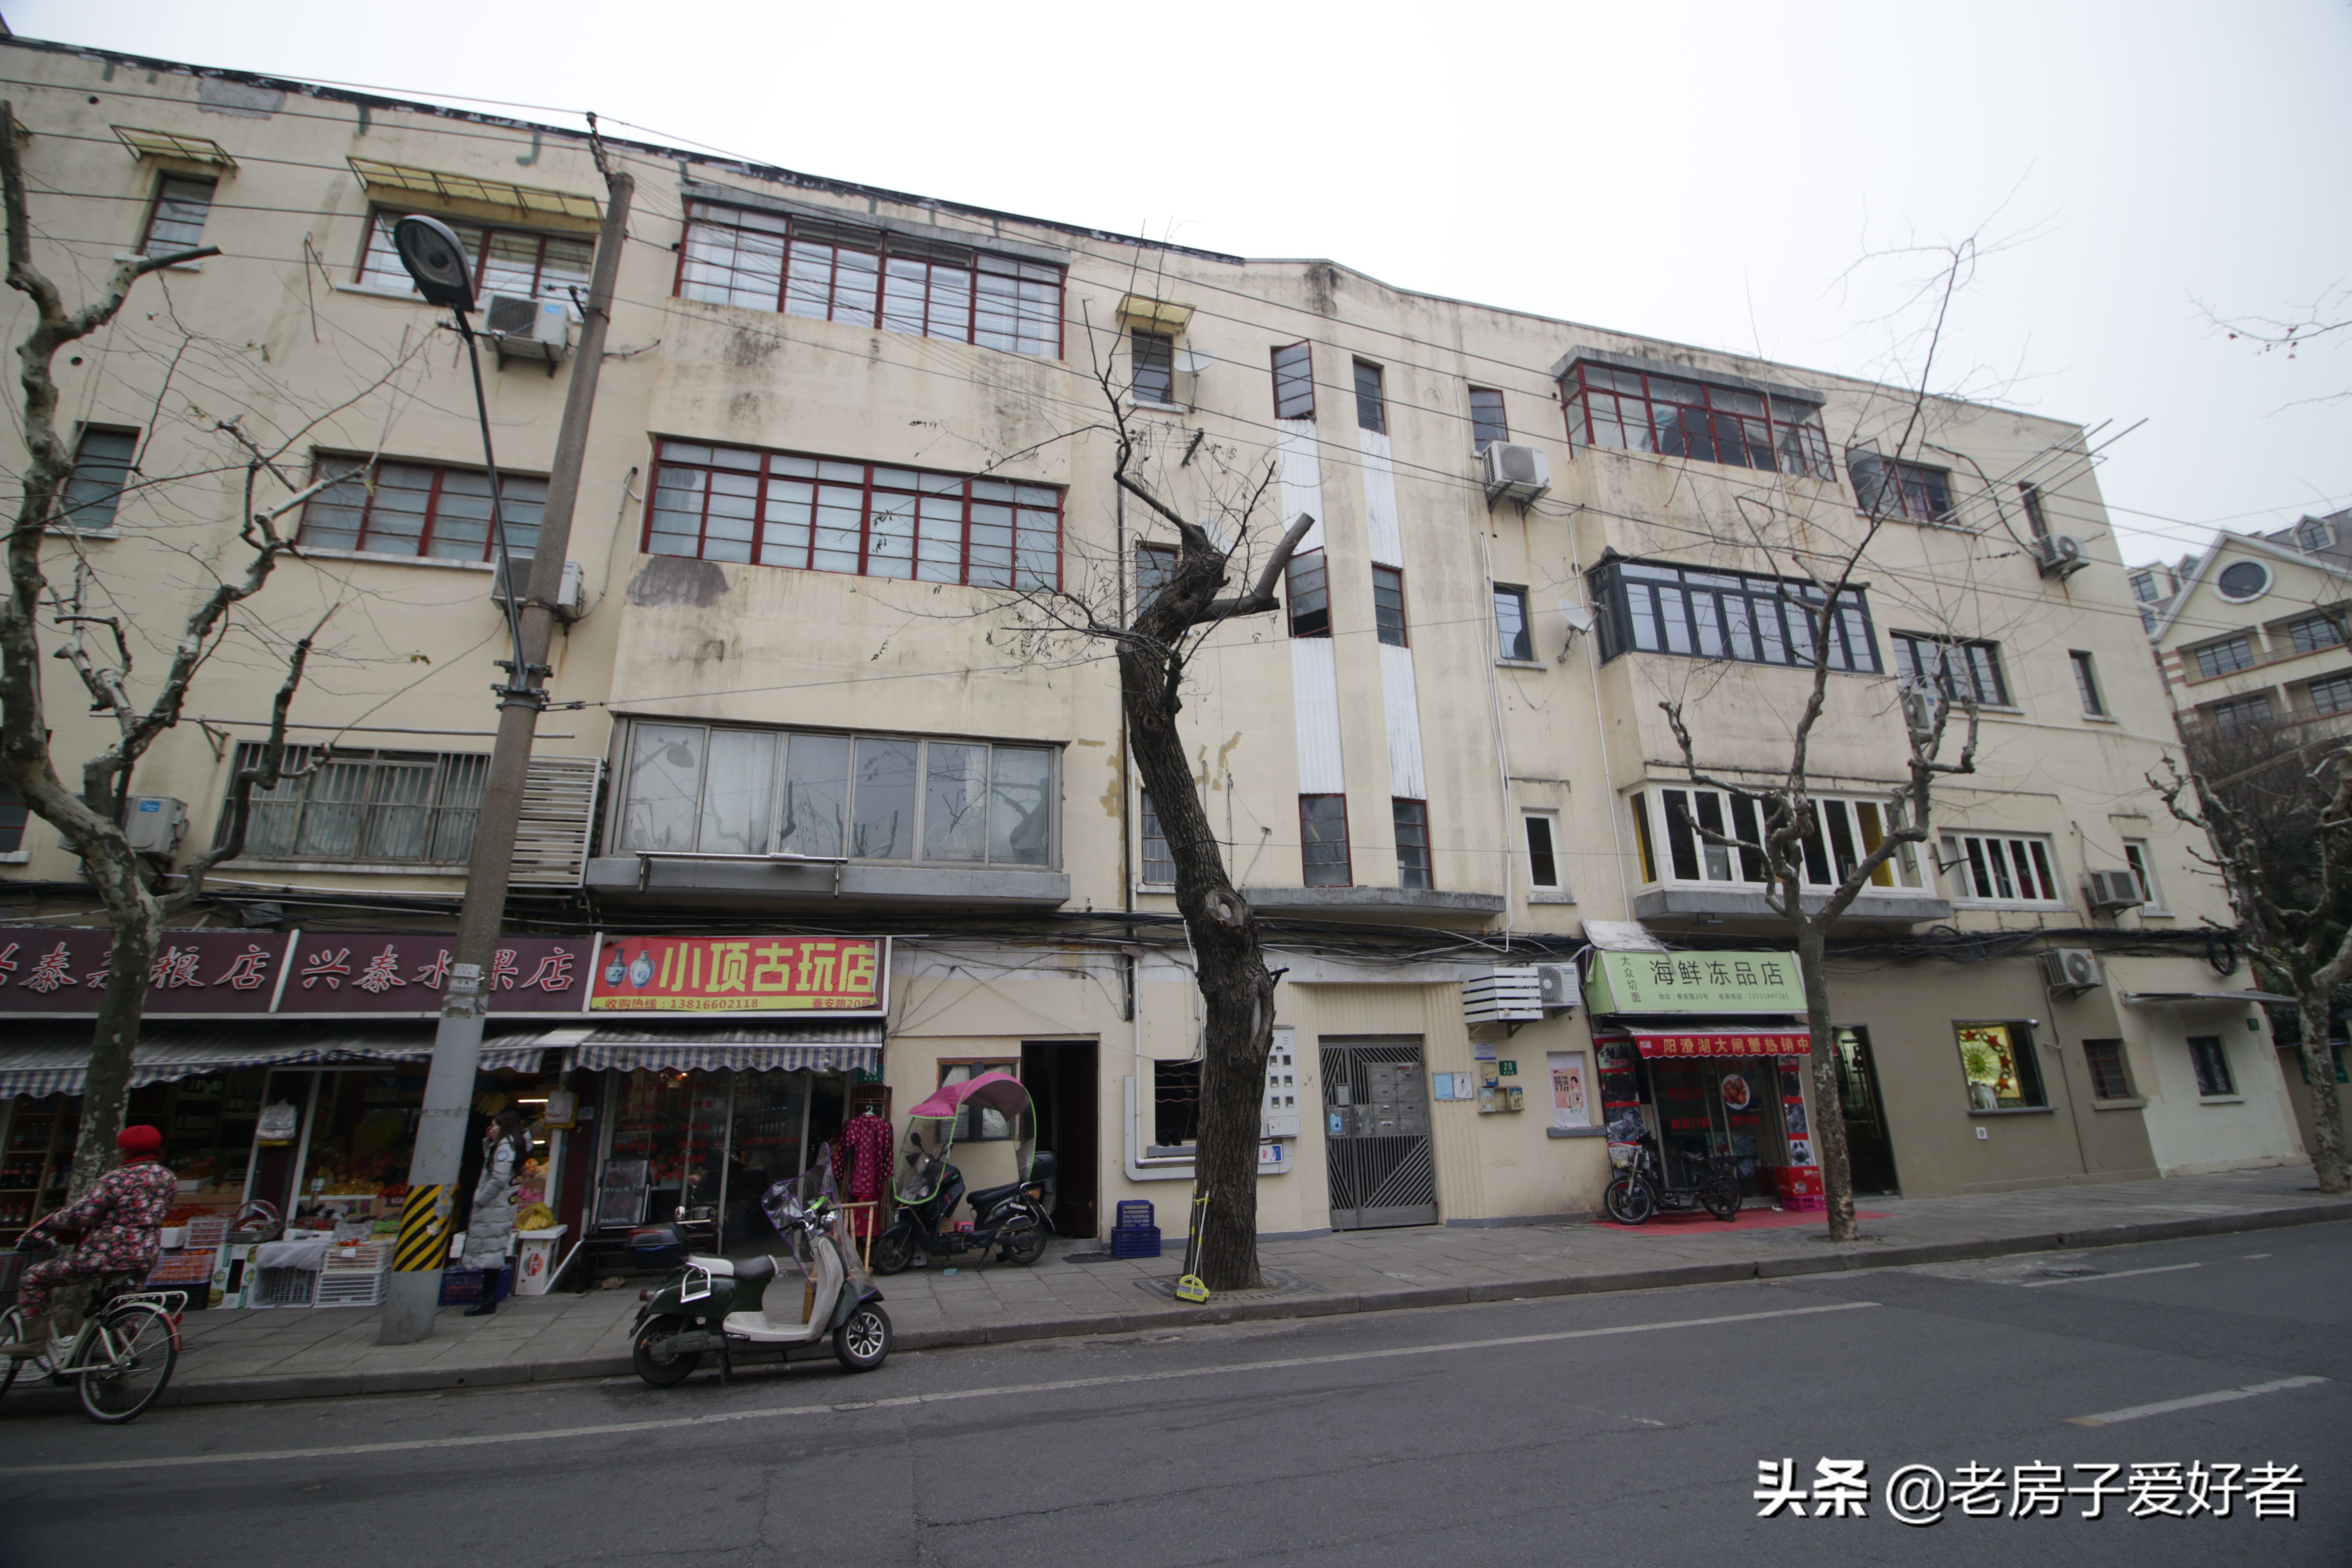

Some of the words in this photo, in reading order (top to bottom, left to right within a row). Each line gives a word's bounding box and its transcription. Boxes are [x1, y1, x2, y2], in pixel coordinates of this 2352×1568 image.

[0, 942, 270, 993] 泰粮店
[659, 942, 875, 992] 小顶古玩店
[1620, 956, 1641, 1003] 大众切面
[1649, 960, 1784, 986] 海鲜冻品店
[1663, 1037, 1810, 1054] 阳澄湖大闸蟹热销中
[1504, 1062, 1513, 1070] 20
